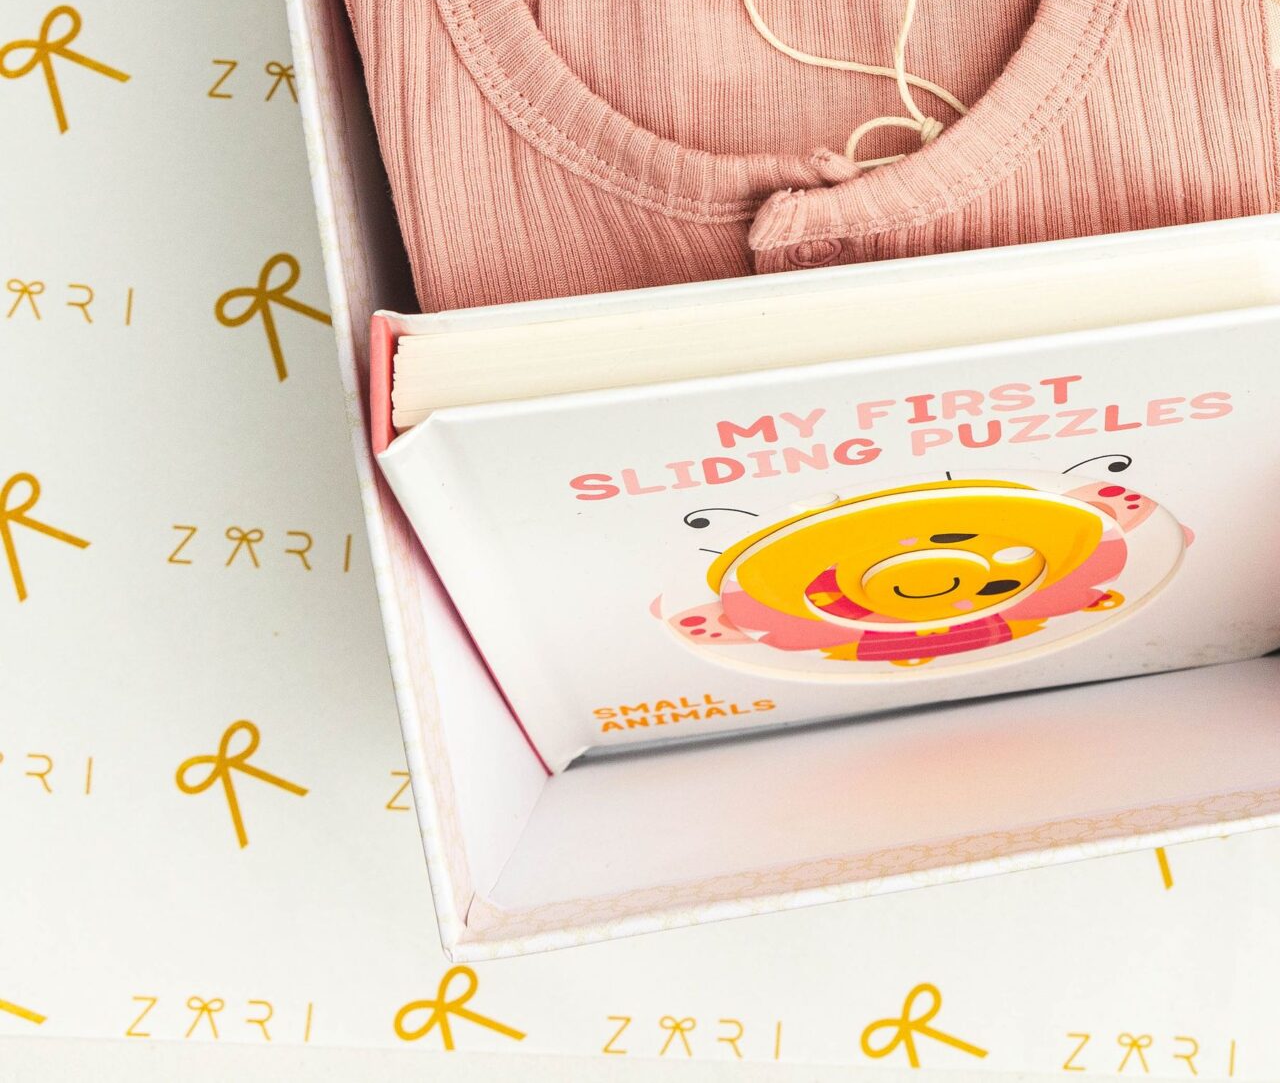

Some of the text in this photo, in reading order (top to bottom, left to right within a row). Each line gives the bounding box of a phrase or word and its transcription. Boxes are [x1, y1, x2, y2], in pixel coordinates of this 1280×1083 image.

[4, 277, 134, 327] ARI
[717, 374, 1083, 449] MY FIRST
[569, 391, 1234, 501] SLIDING PUZZLES
[593, 693, 725, 719] SMALL
[601, 699, 777, 733] ANIMALS
